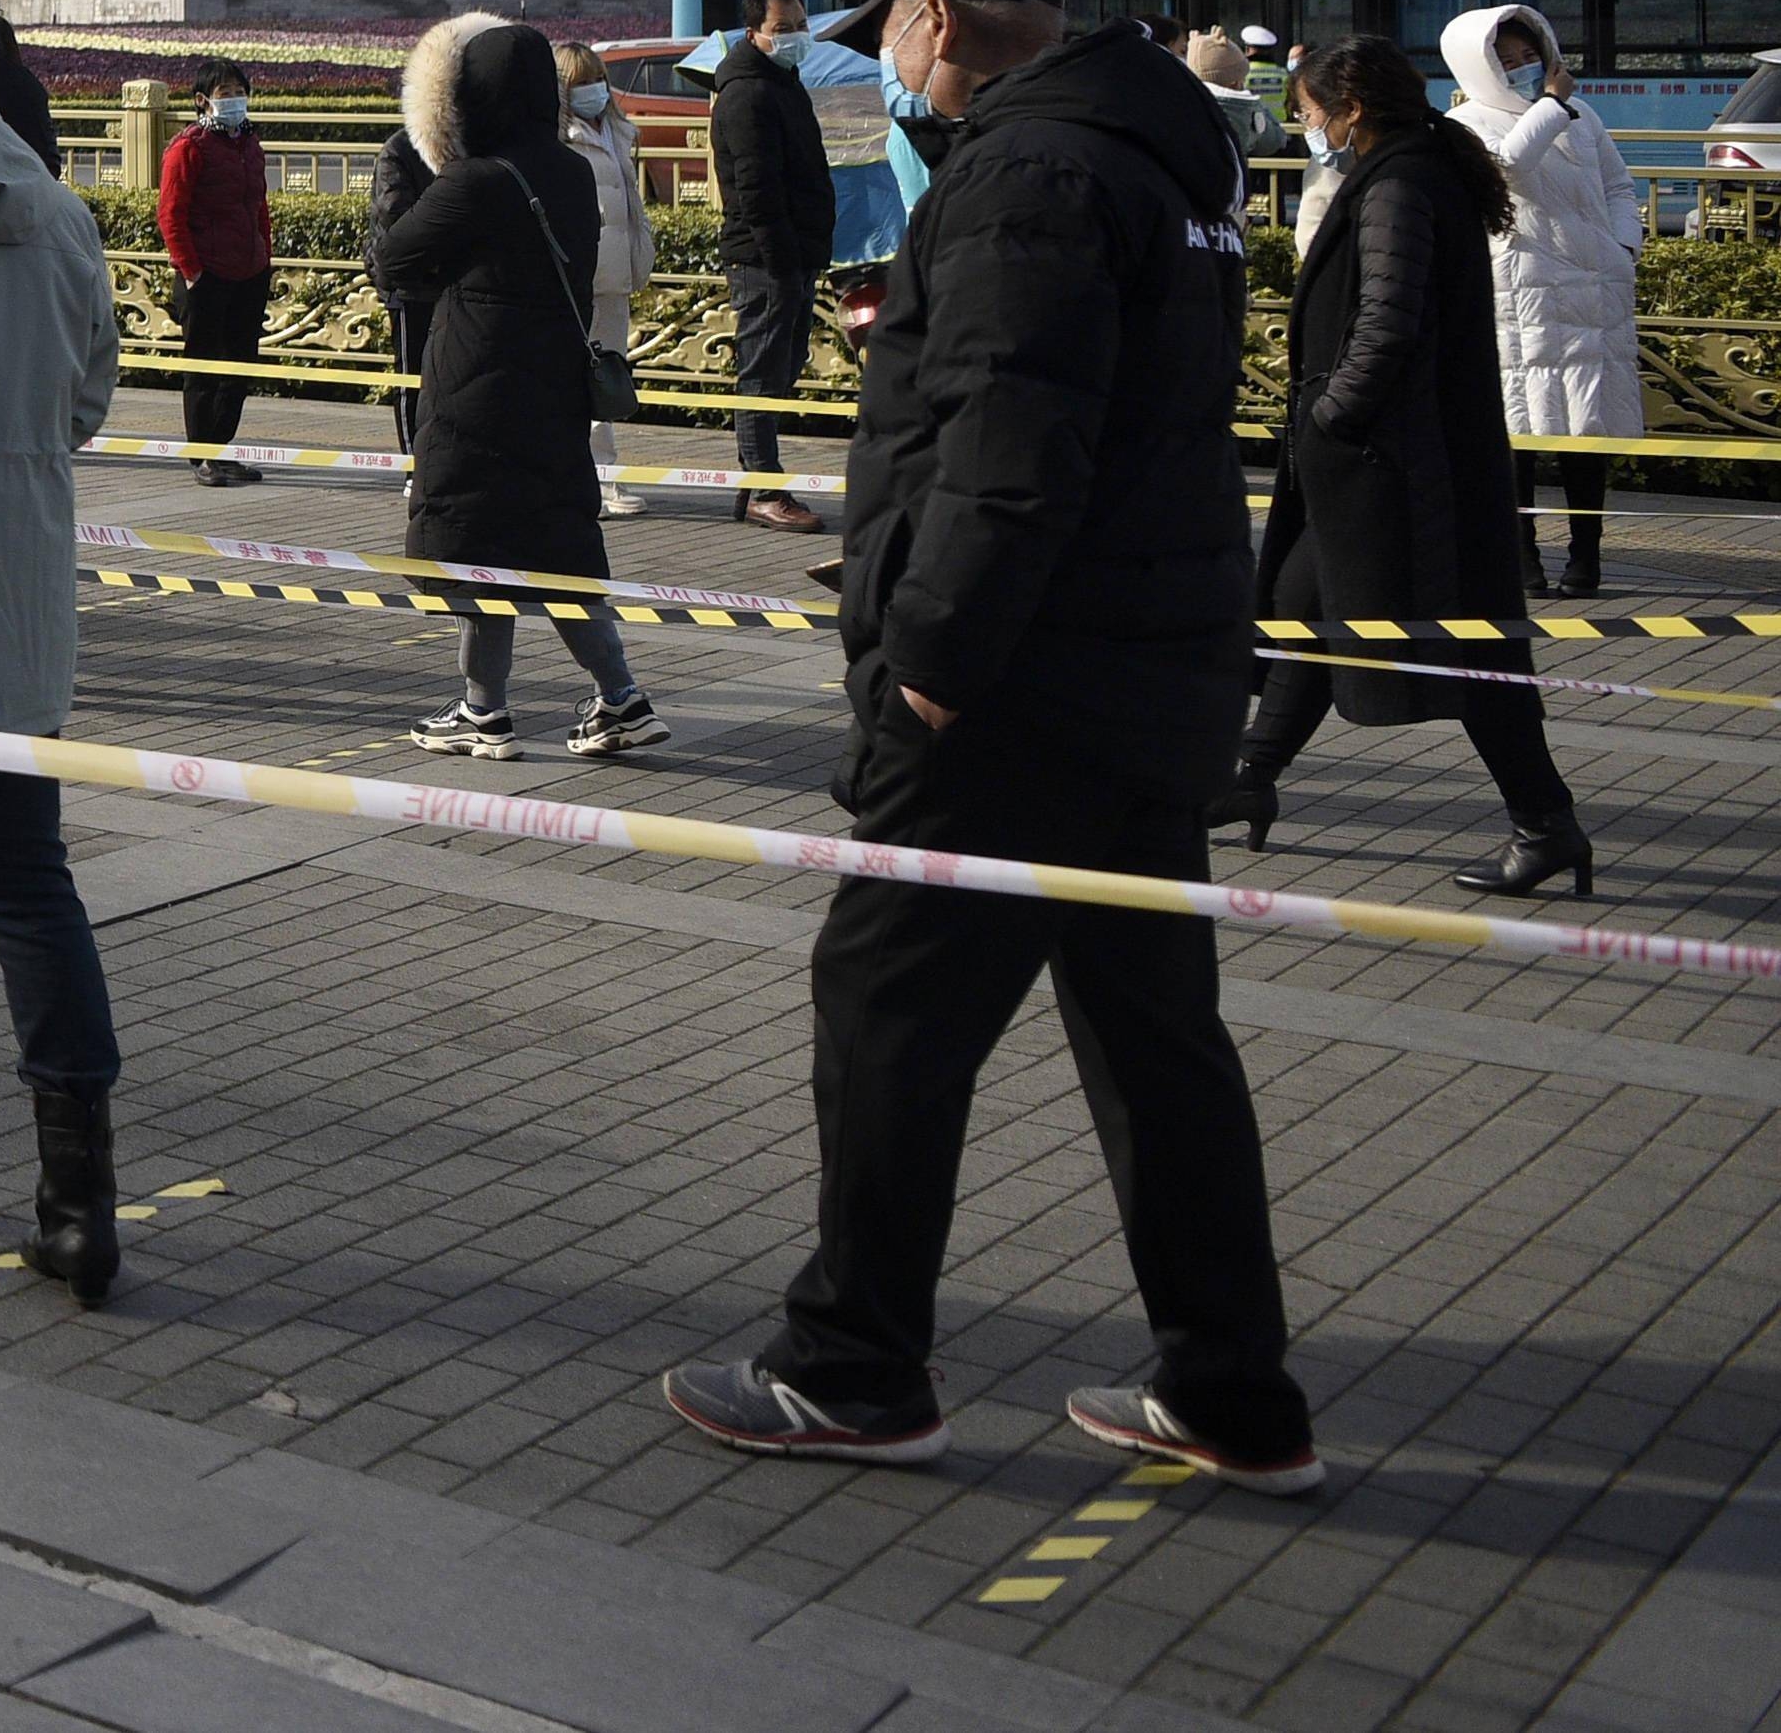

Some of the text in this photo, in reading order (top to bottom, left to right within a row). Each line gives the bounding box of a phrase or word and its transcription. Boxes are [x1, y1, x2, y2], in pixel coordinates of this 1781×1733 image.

[234, 446, 286, 462] LIMITLINE
[351, 453, 394, 468] 警戒线
[681, 470, 727, 485] 警戒线
